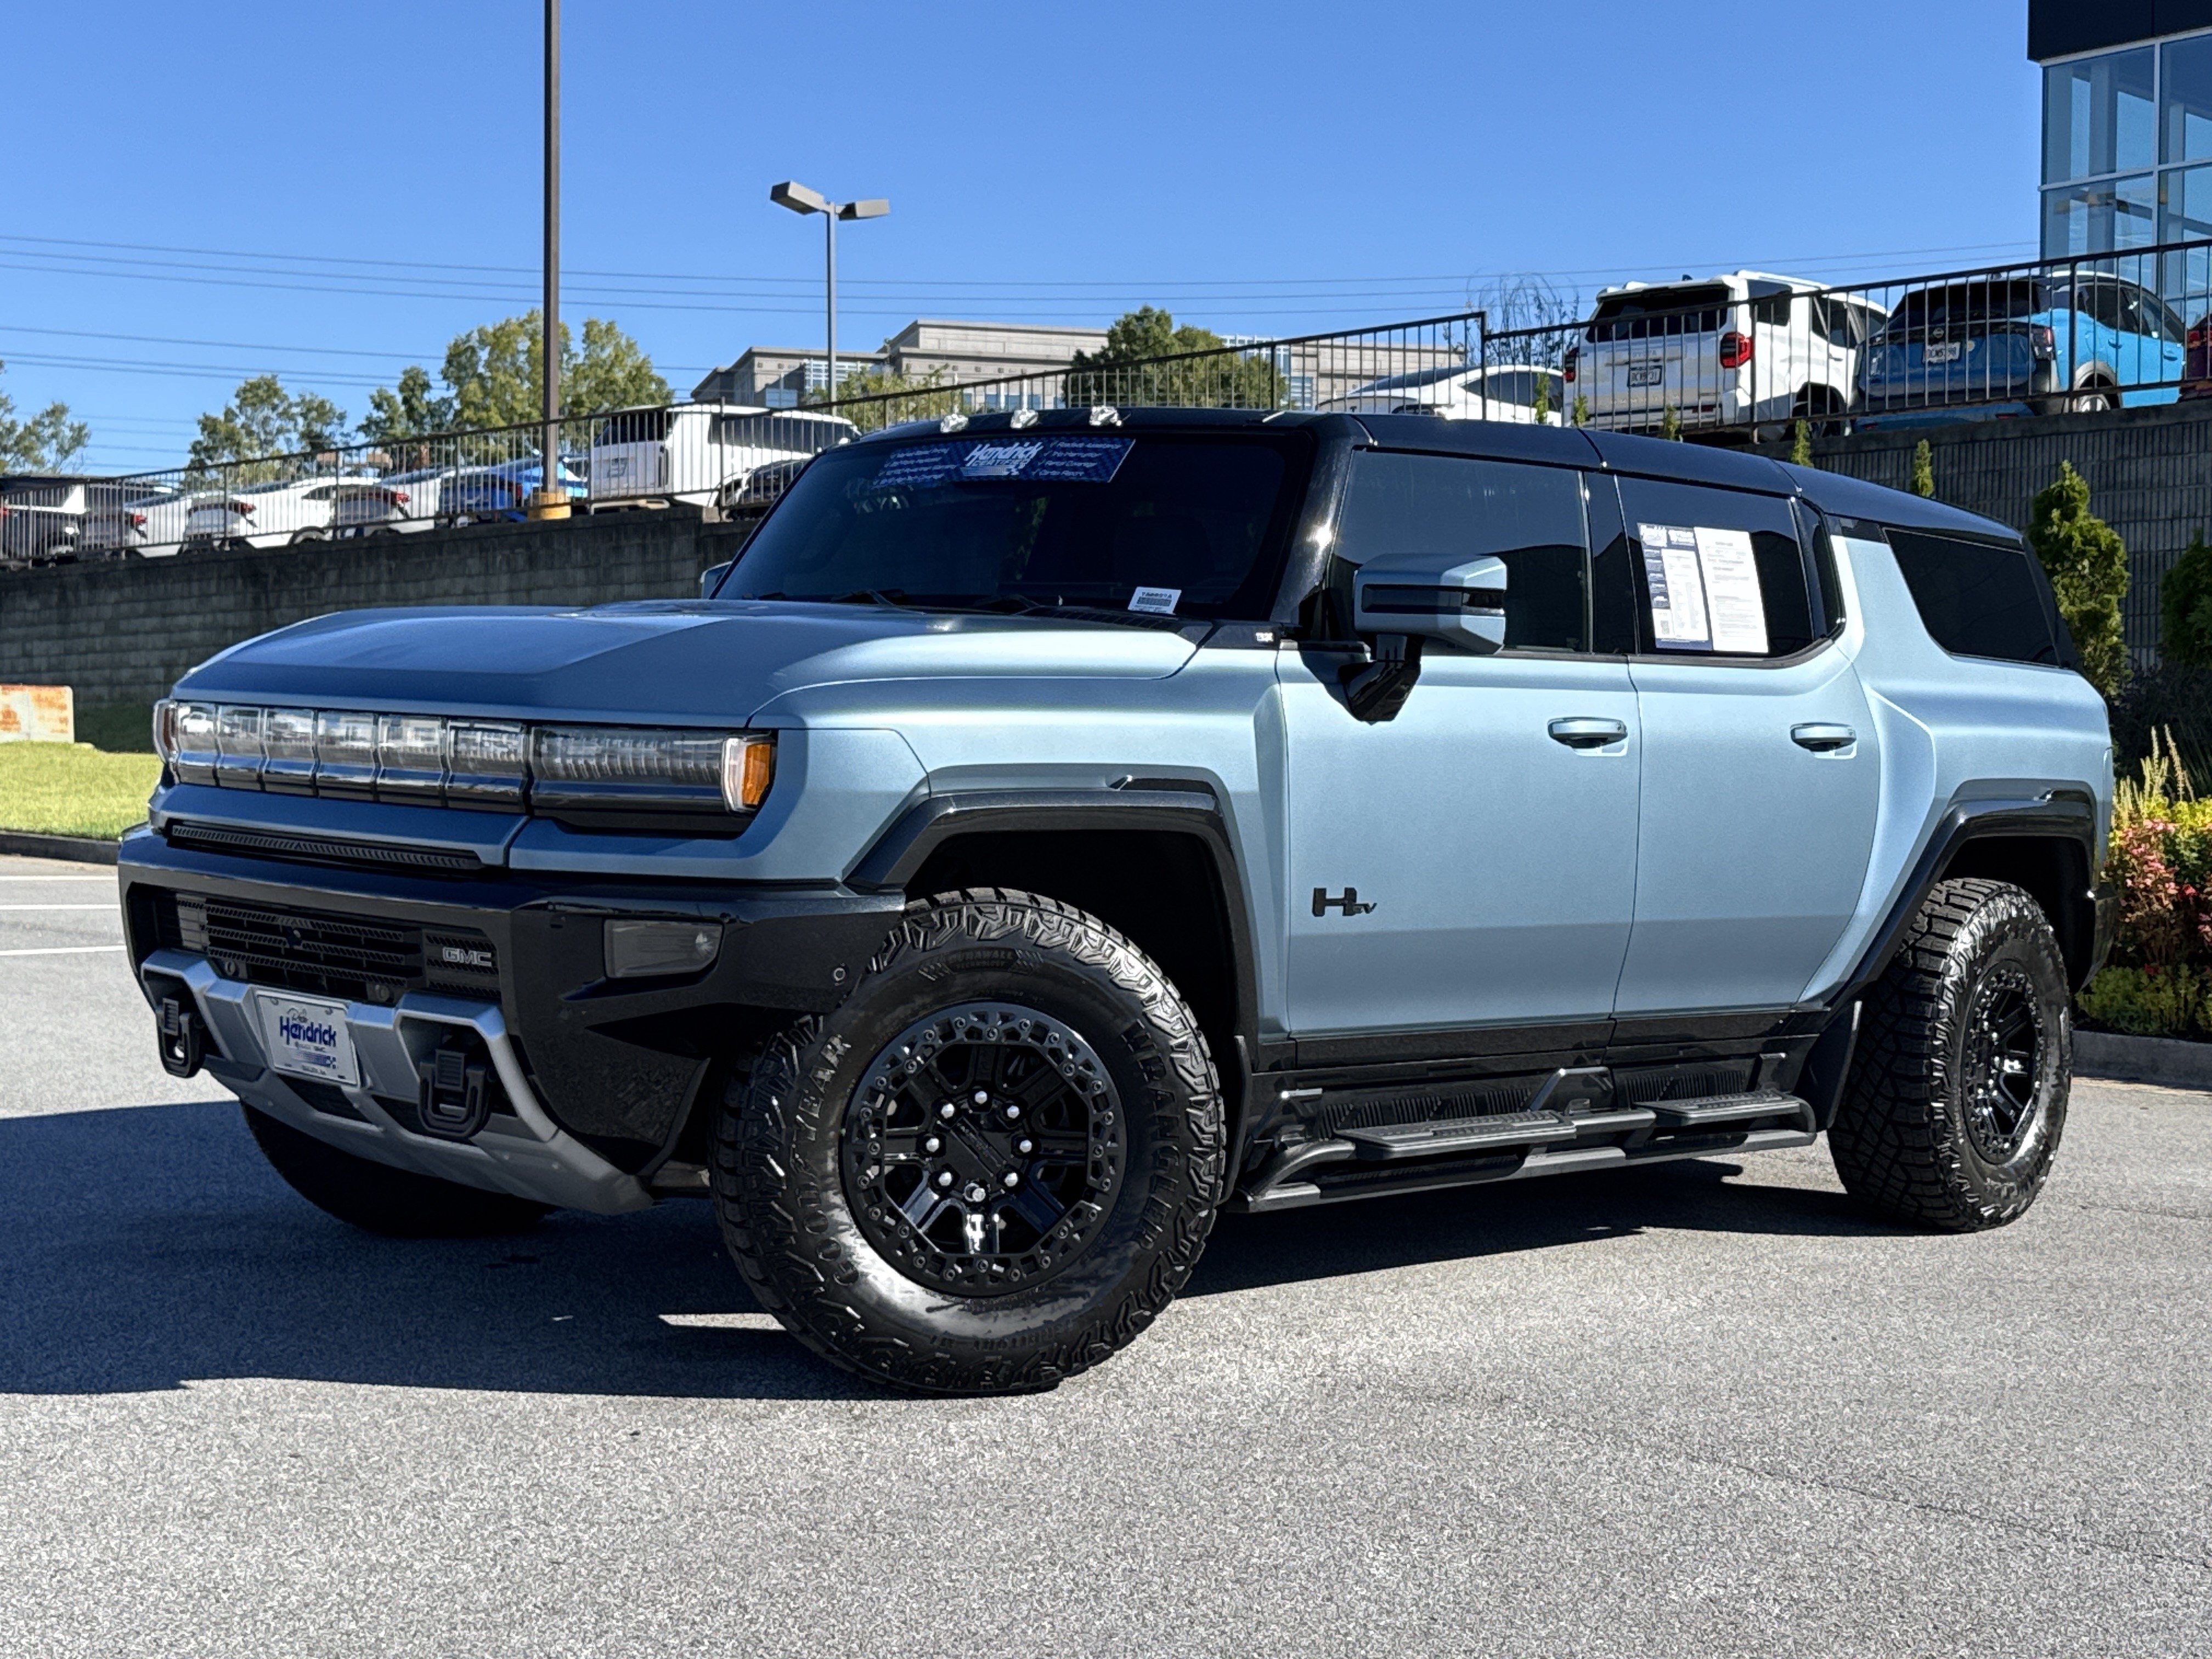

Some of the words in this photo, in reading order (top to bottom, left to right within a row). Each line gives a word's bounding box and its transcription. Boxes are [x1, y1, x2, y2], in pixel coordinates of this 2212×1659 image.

[964, 442, 1044, 469] Hendrick
[442, 946, 492, 967] GMC
[279, 1015, 337, 1048] Hendrick
[1121, 1018, 1180, 1251] WRANGLER
[790, 1034, 859, 1285] GOODYEAR
